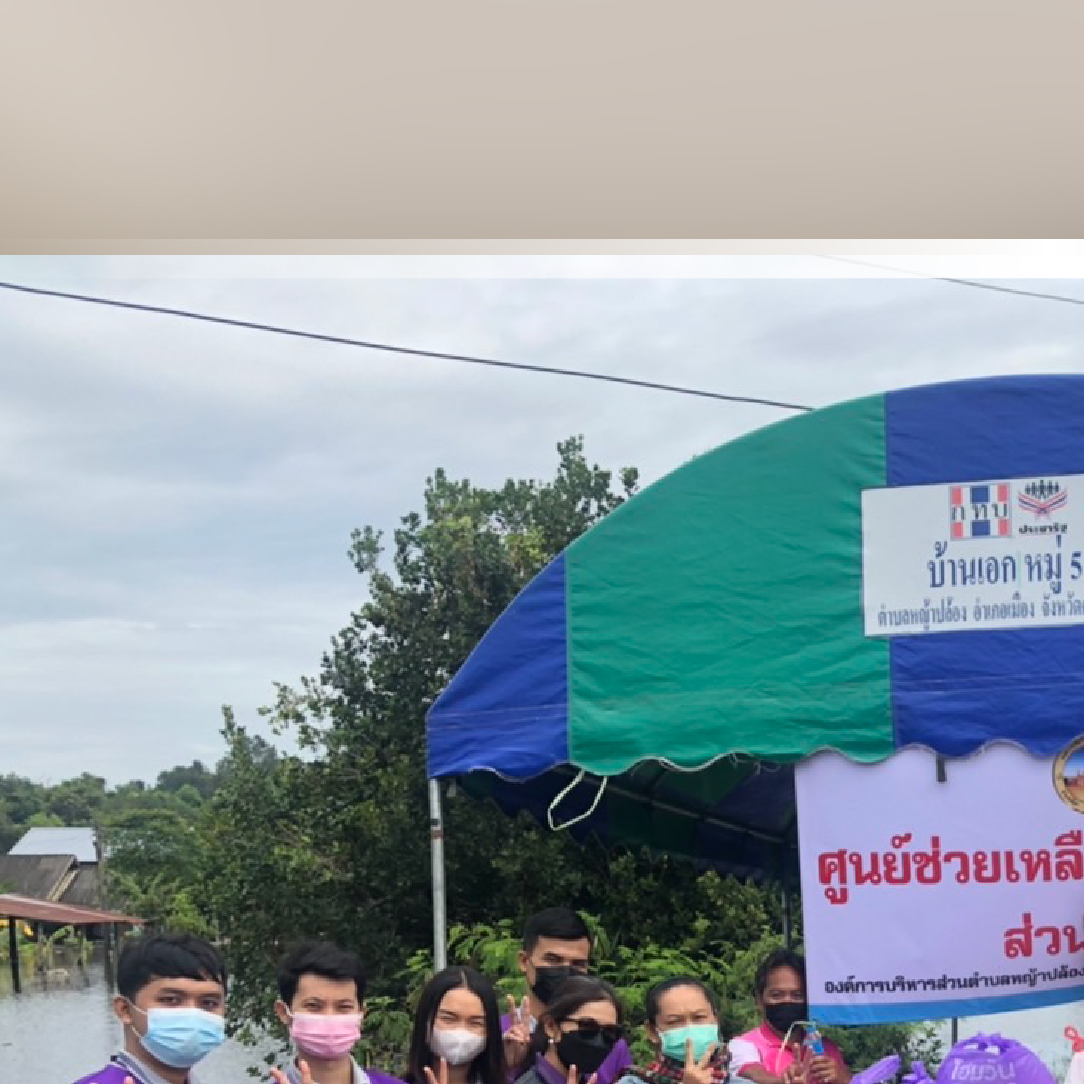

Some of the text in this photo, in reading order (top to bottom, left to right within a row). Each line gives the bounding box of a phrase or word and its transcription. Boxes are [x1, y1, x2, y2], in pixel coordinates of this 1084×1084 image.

[927, 534, 1083, 593] บ้านเอก หมู่ 5
